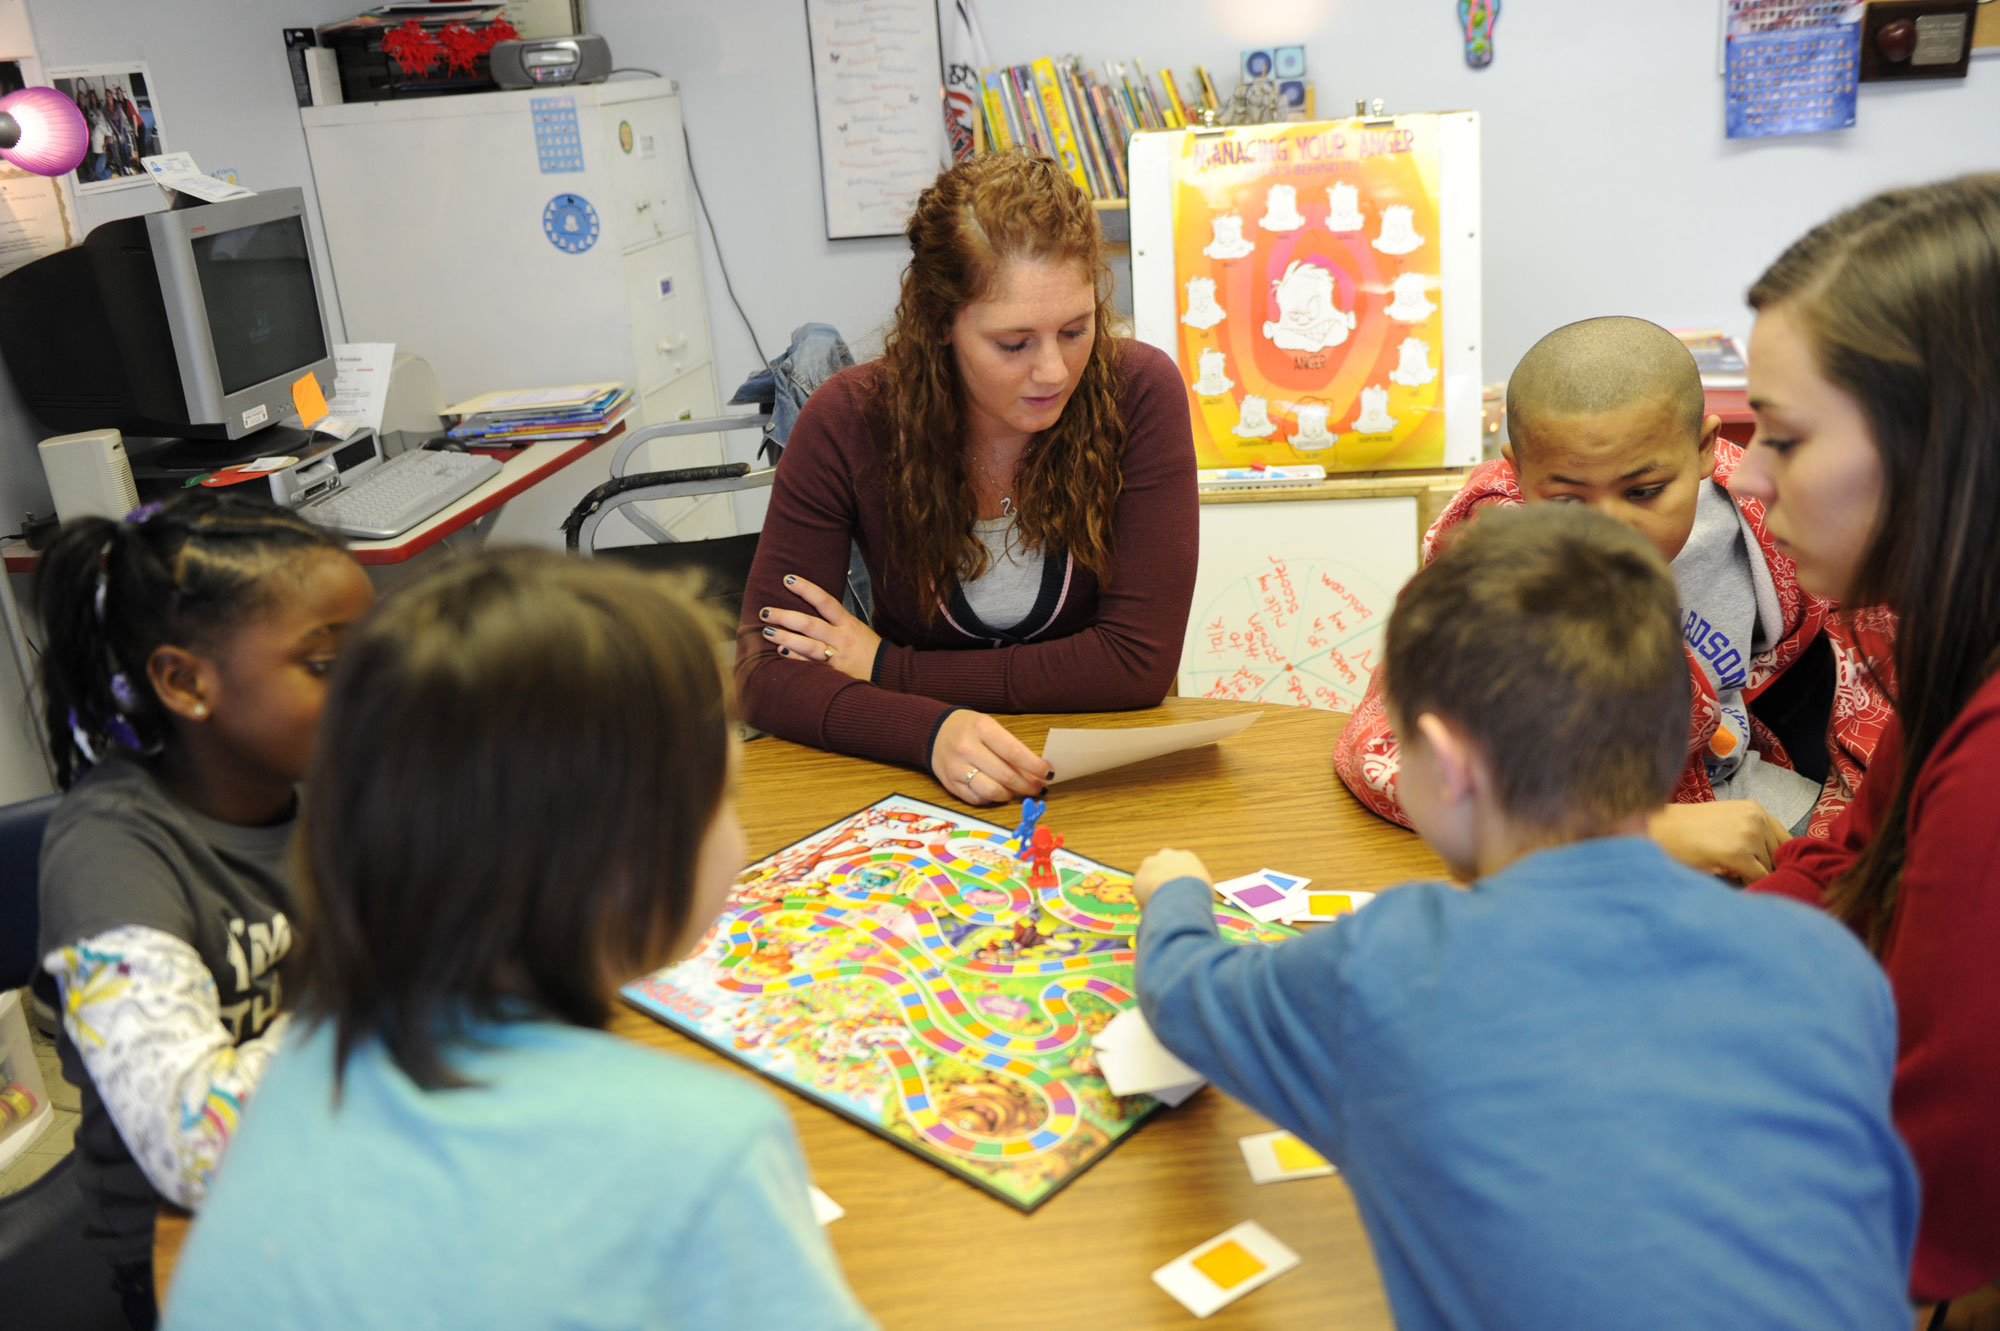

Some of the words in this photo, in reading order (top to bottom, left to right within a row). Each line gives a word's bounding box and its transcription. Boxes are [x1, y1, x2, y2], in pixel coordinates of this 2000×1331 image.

[1193, 136, 1288, 168] MANAGING
[1296, 132, 1346, 161] YOUR
[1360, 128, 1414, 158] ANGER
[1294, 161, 1339, 177] BEHIND
[1293, 355, 1327, 371] ANGER
[1267, 555, 1300, 615] scooter
[1321, 572, 1374, 625] bedroom
[1263, 596, 1288, 629] ride
[1206, 616, 1226, 660] talk
[1229, 631, 1245, 650] to
[1680, 608, 1747, 692] RDSON
